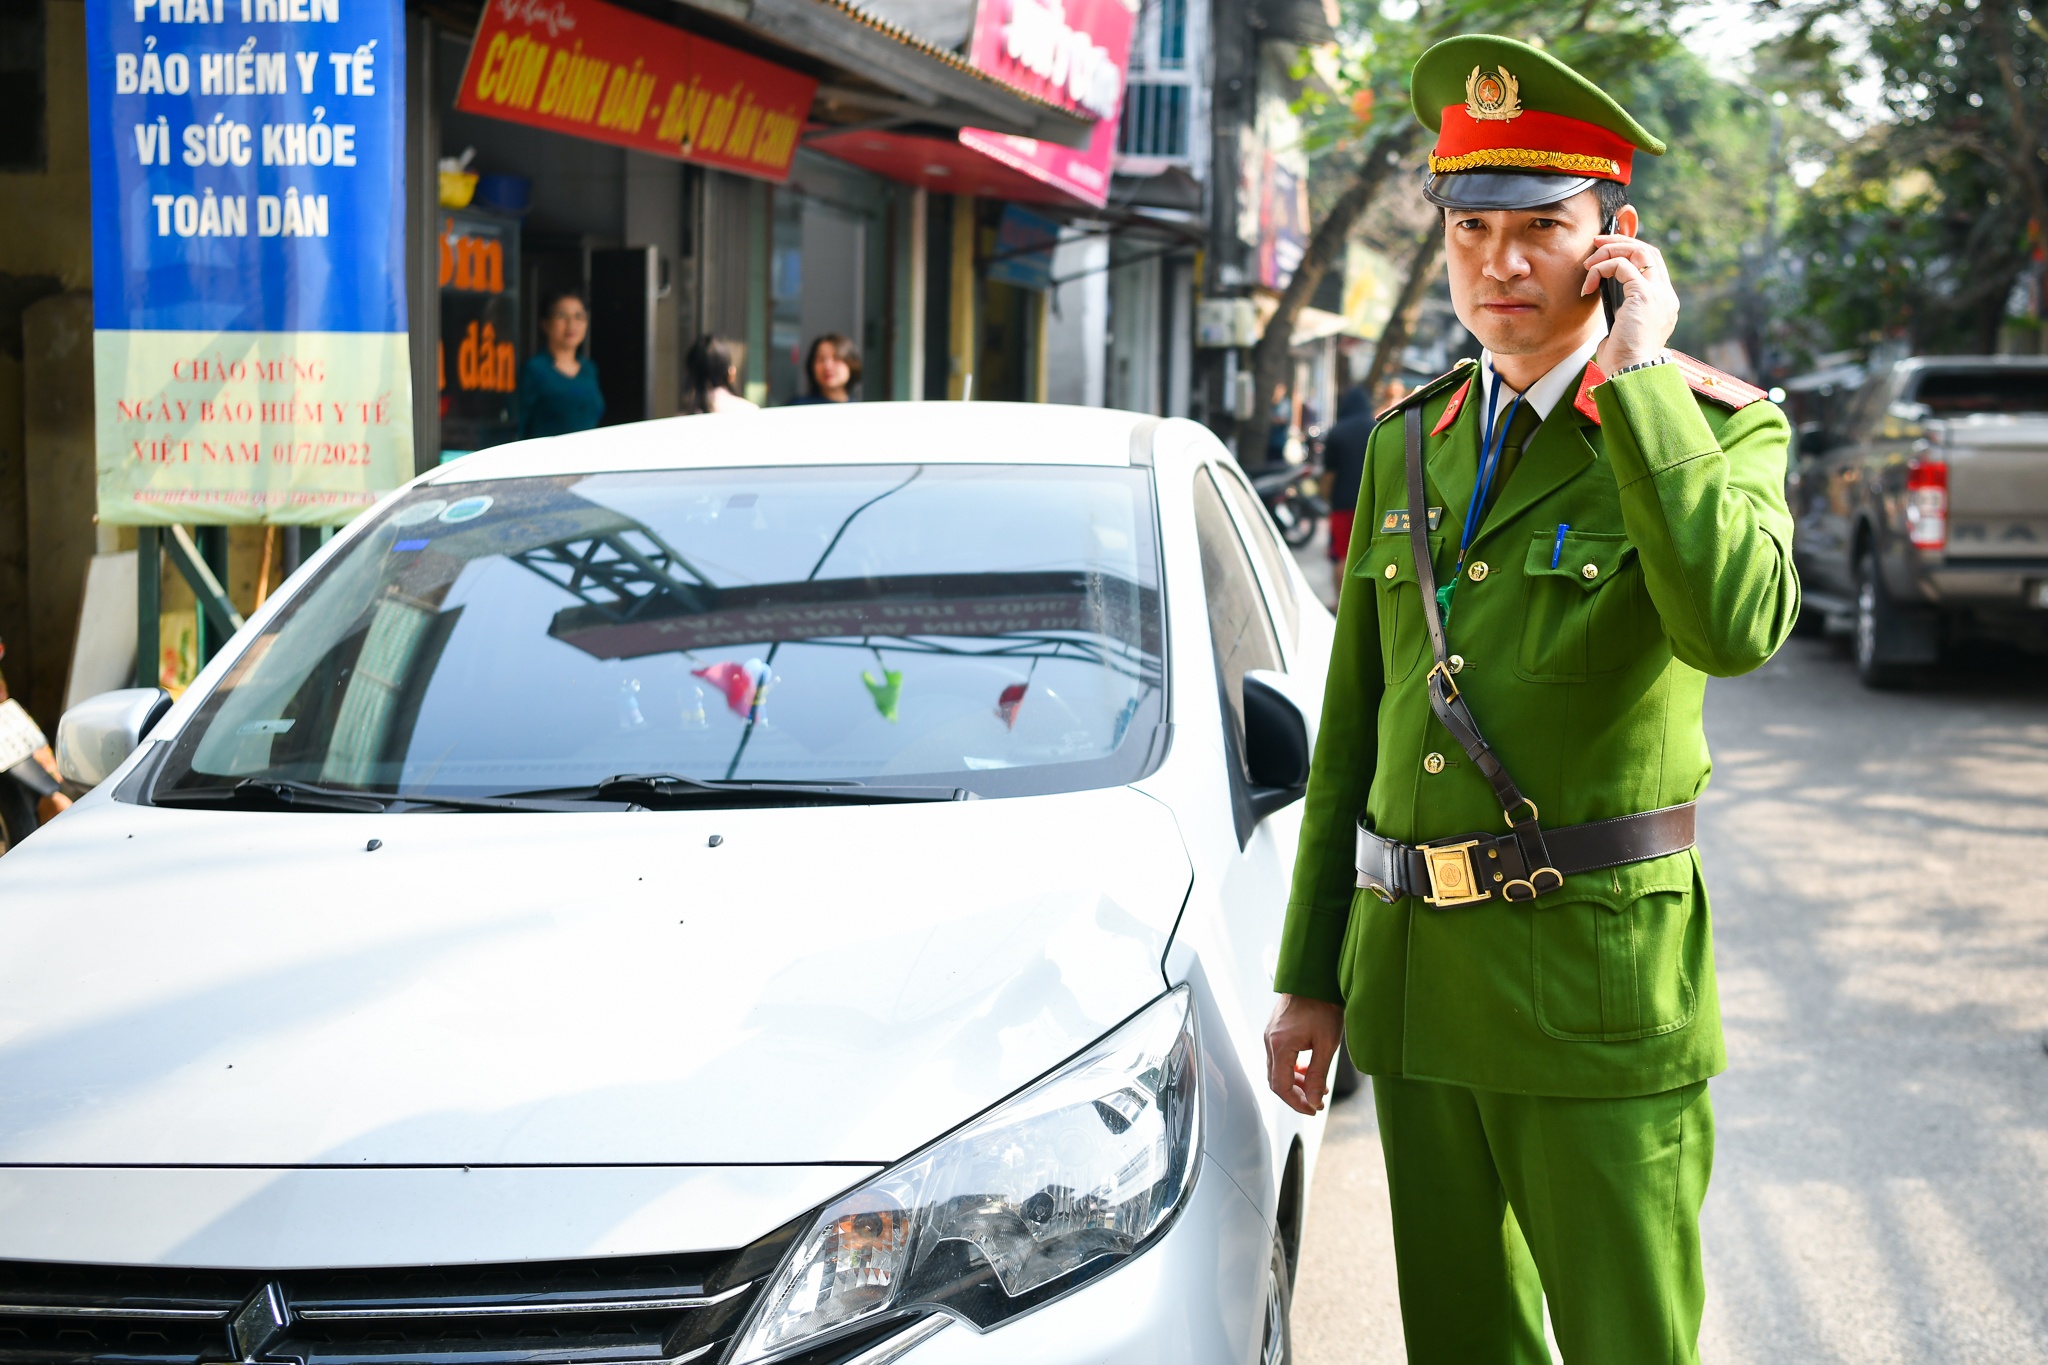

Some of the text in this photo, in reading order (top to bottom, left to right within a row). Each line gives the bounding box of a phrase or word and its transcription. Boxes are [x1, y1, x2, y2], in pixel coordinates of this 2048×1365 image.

[116, 35, 378, 97] BẢO HIỂM Y TẾ
[477, 31, 549, 111] CƠM
[134, 106, 357, 167] VÌ SỨC KHỎE
[152, 186, 330, 238] TOÀN DÂN
[172, 351, 325, 384] CHÀO MỪNG
[457, 320, 516, 392] dân
[116, 389, 392, 425] NGÀY BẢO HIỂM Y TẾ
[132, 433, 371, 468] VIỆT NAM 01/7/2022
